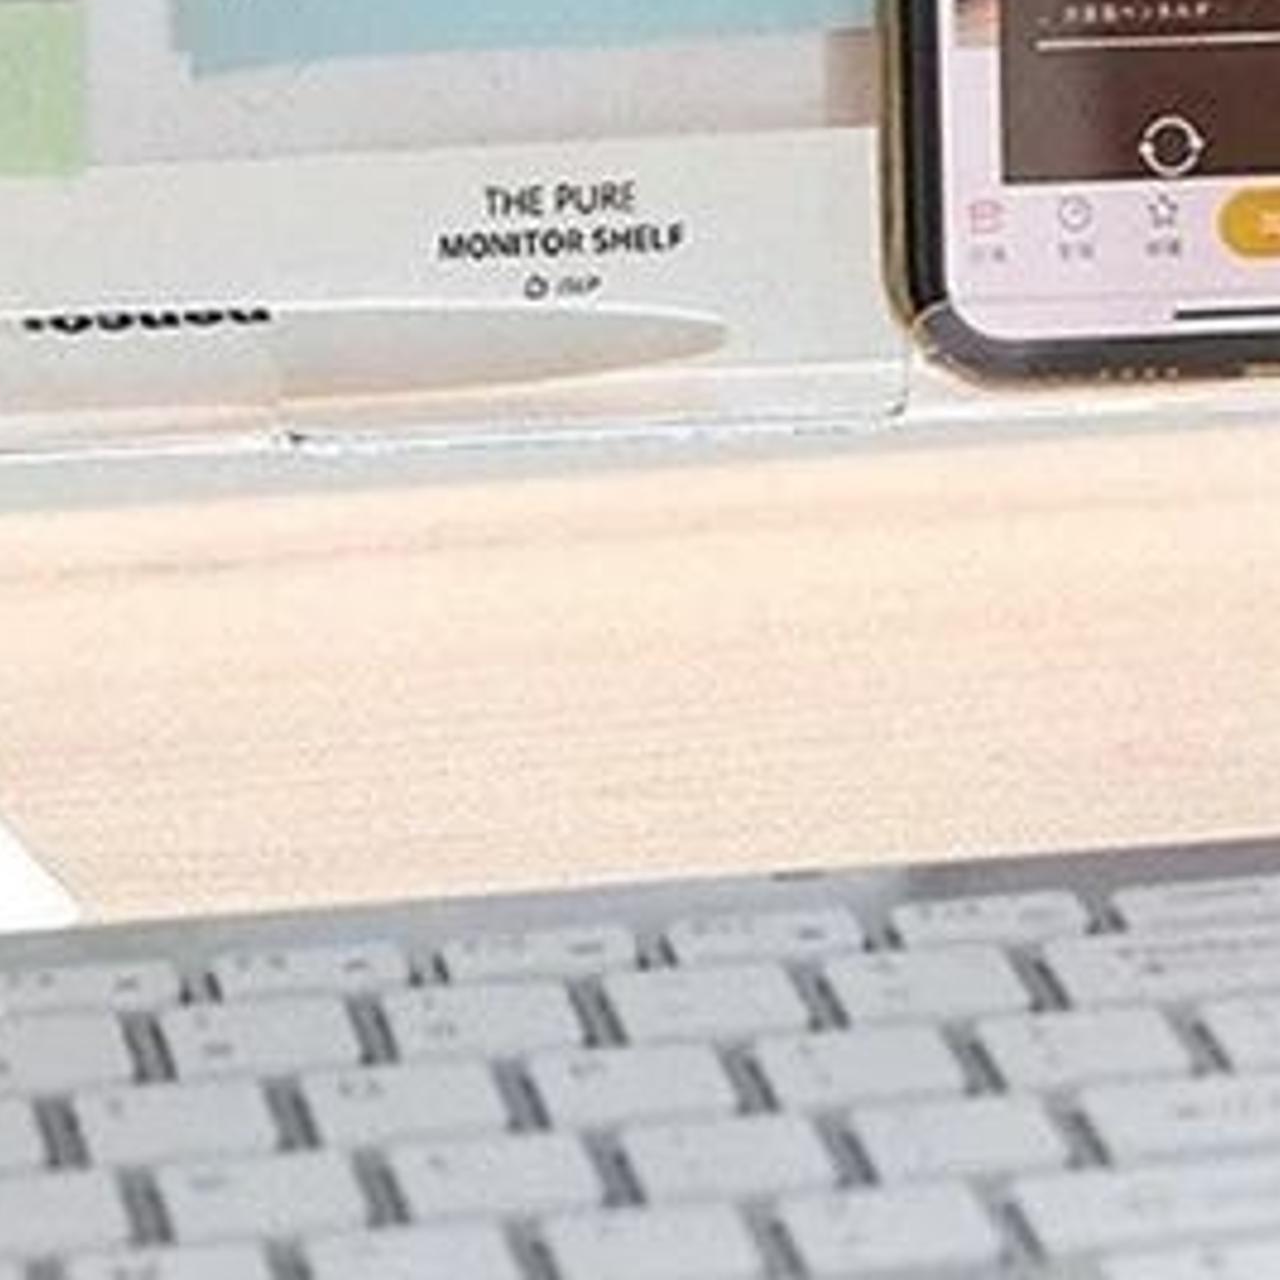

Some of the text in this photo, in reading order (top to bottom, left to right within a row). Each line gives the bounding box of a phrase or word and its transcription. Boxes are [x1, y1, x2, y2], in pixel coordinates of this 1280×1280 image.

[484, 179, 637, 218] THE PURE
[437, 221, 686, 260] MONITOR SHELF
